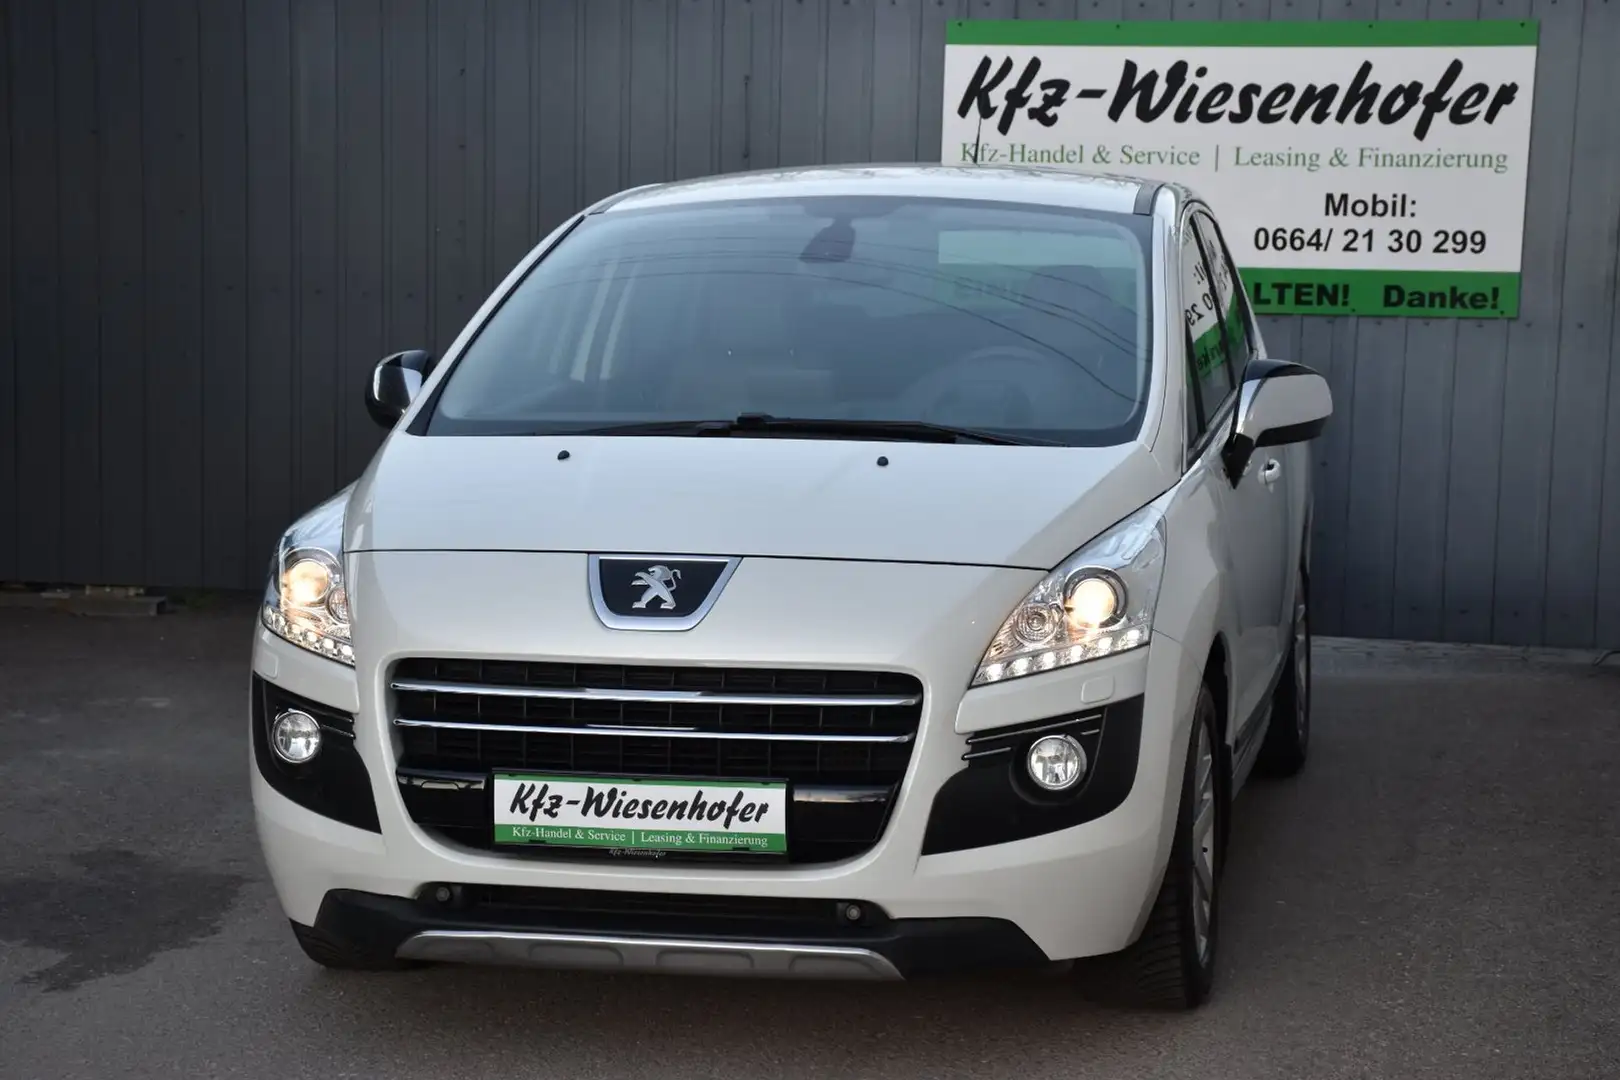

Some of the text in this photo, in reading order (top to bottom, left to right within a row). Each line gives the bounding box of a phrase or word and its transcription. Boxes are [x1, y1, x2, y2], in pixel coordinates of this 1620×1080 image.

[957, 55, 1519, 141] Kfz-Wiesenhofer
[960, 142, 1508, 173] Kfz-Handel & Service Leasing & Finanzierung
[1324, 192, 1417, 218] Mobil:
[1254, 227, 1487, 255] 0664/ 21 30 299
[1382, 284, 1500, 310] Danke!
[509, 783, 769, 829] Kfz-Wiesenhofer
[512, 826, 768, 847] Kfz-Handel & Service Leasing & Finanzierung
